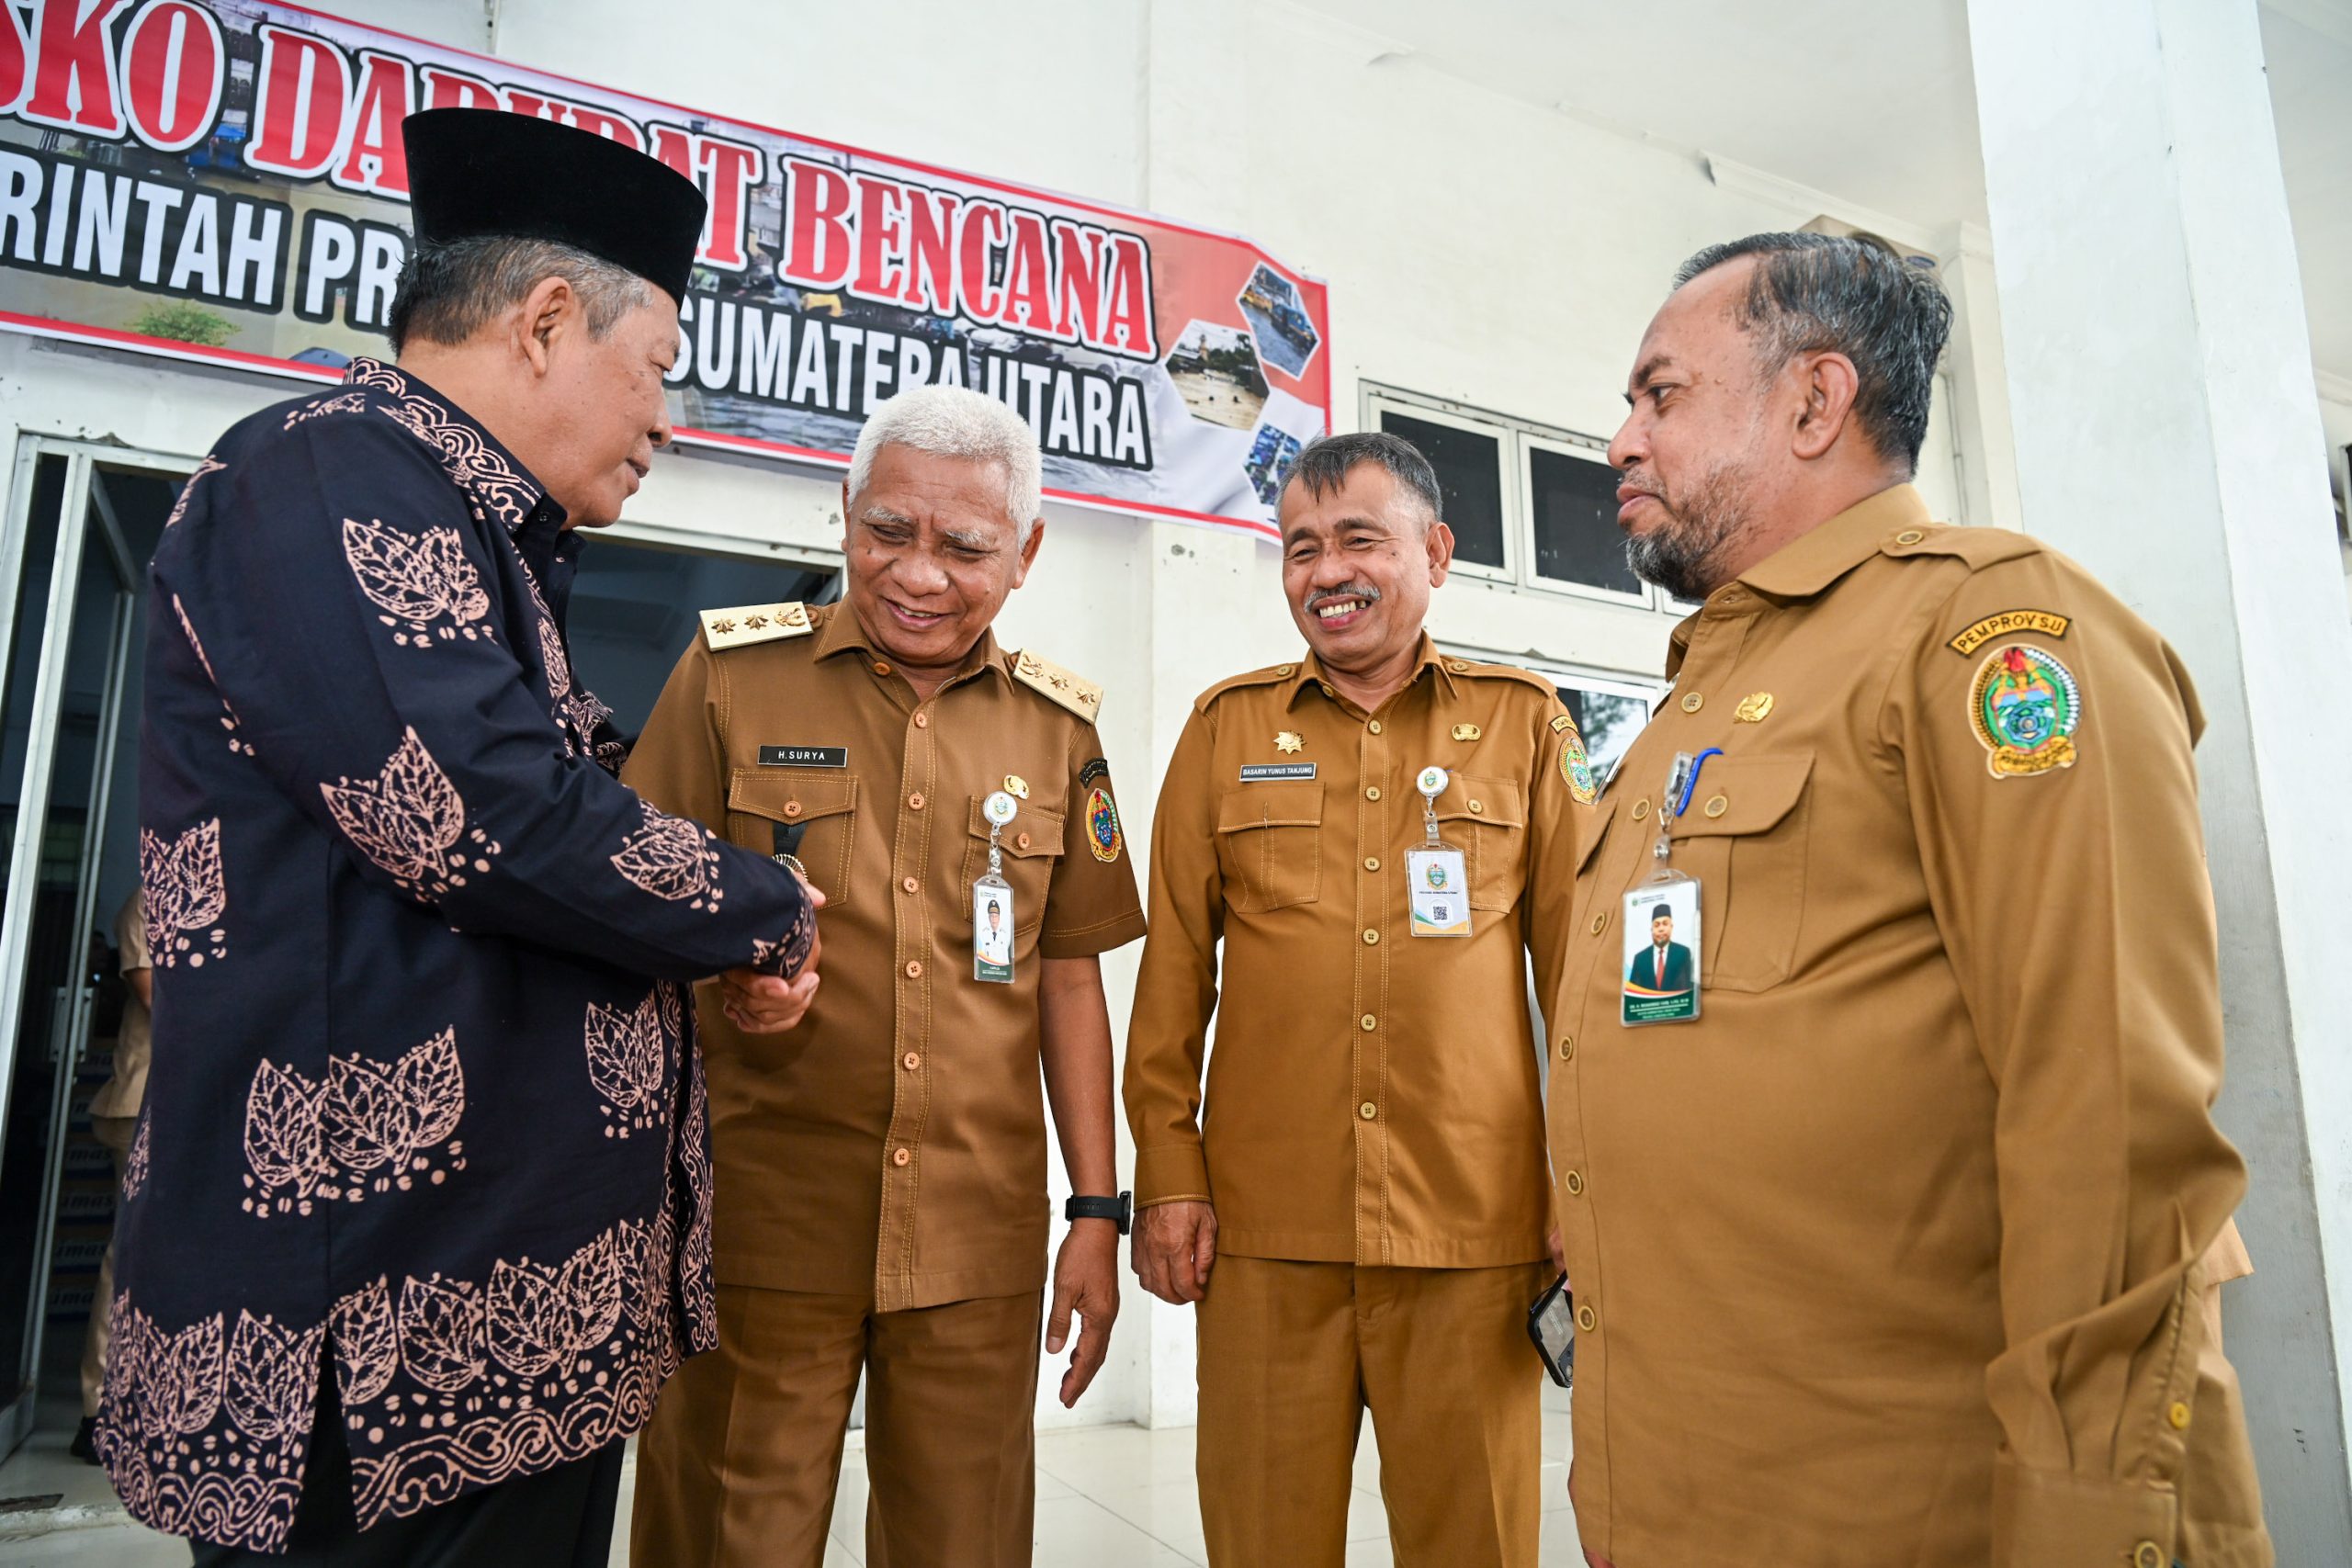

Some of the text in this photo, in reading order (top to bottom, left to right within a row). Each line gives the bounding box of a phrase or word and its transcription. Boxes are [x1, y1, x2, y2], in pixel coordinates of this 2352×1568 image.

[0, 150, 282, 306] RINTAH
[778, 155, 1157, 360] BENCANA
[1957, 614, 2064, 650] PEMPROV SU
[1242, 768, 1267, 776] BASARIN
